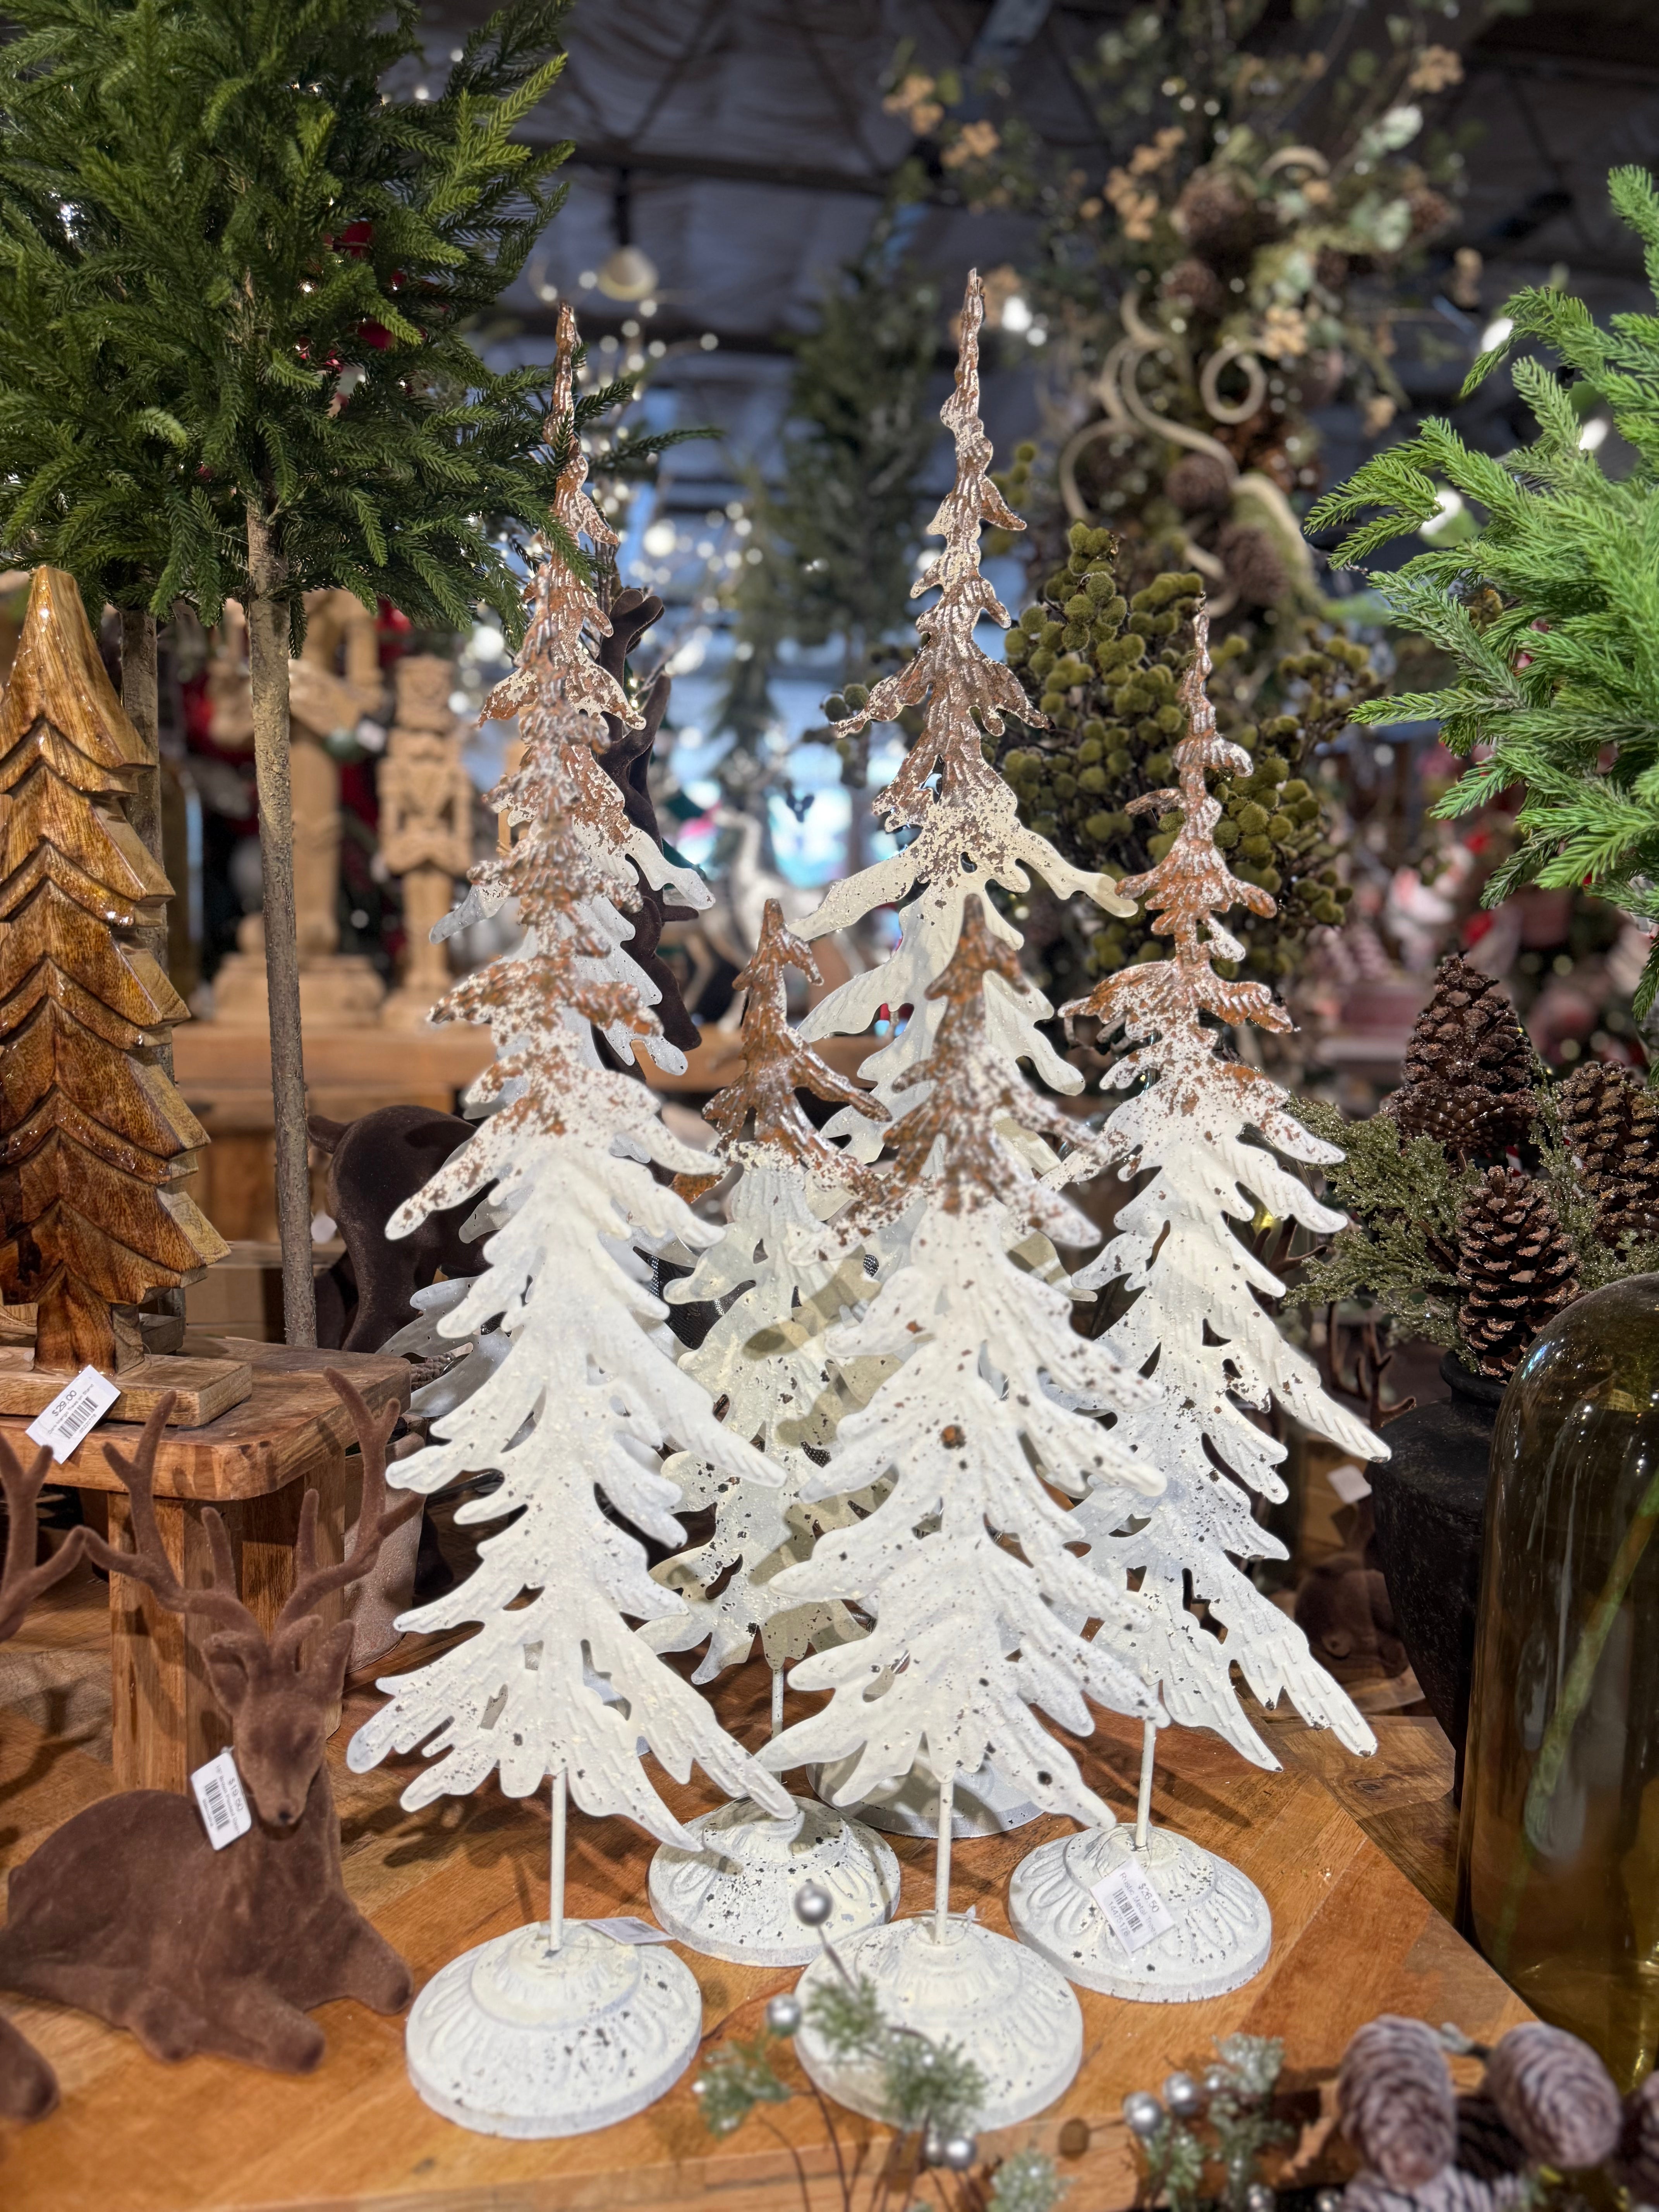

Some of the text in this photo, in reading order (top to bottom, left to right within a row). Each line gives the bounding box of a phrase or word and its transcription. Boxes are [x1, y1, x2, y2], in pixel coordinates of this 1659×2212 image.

[52, 1390, 77, 1417] $29.00
[229, 1777, 244, 1810] $1950
[1119, 1872, 1157, 1936] Rustic Metal Trees
